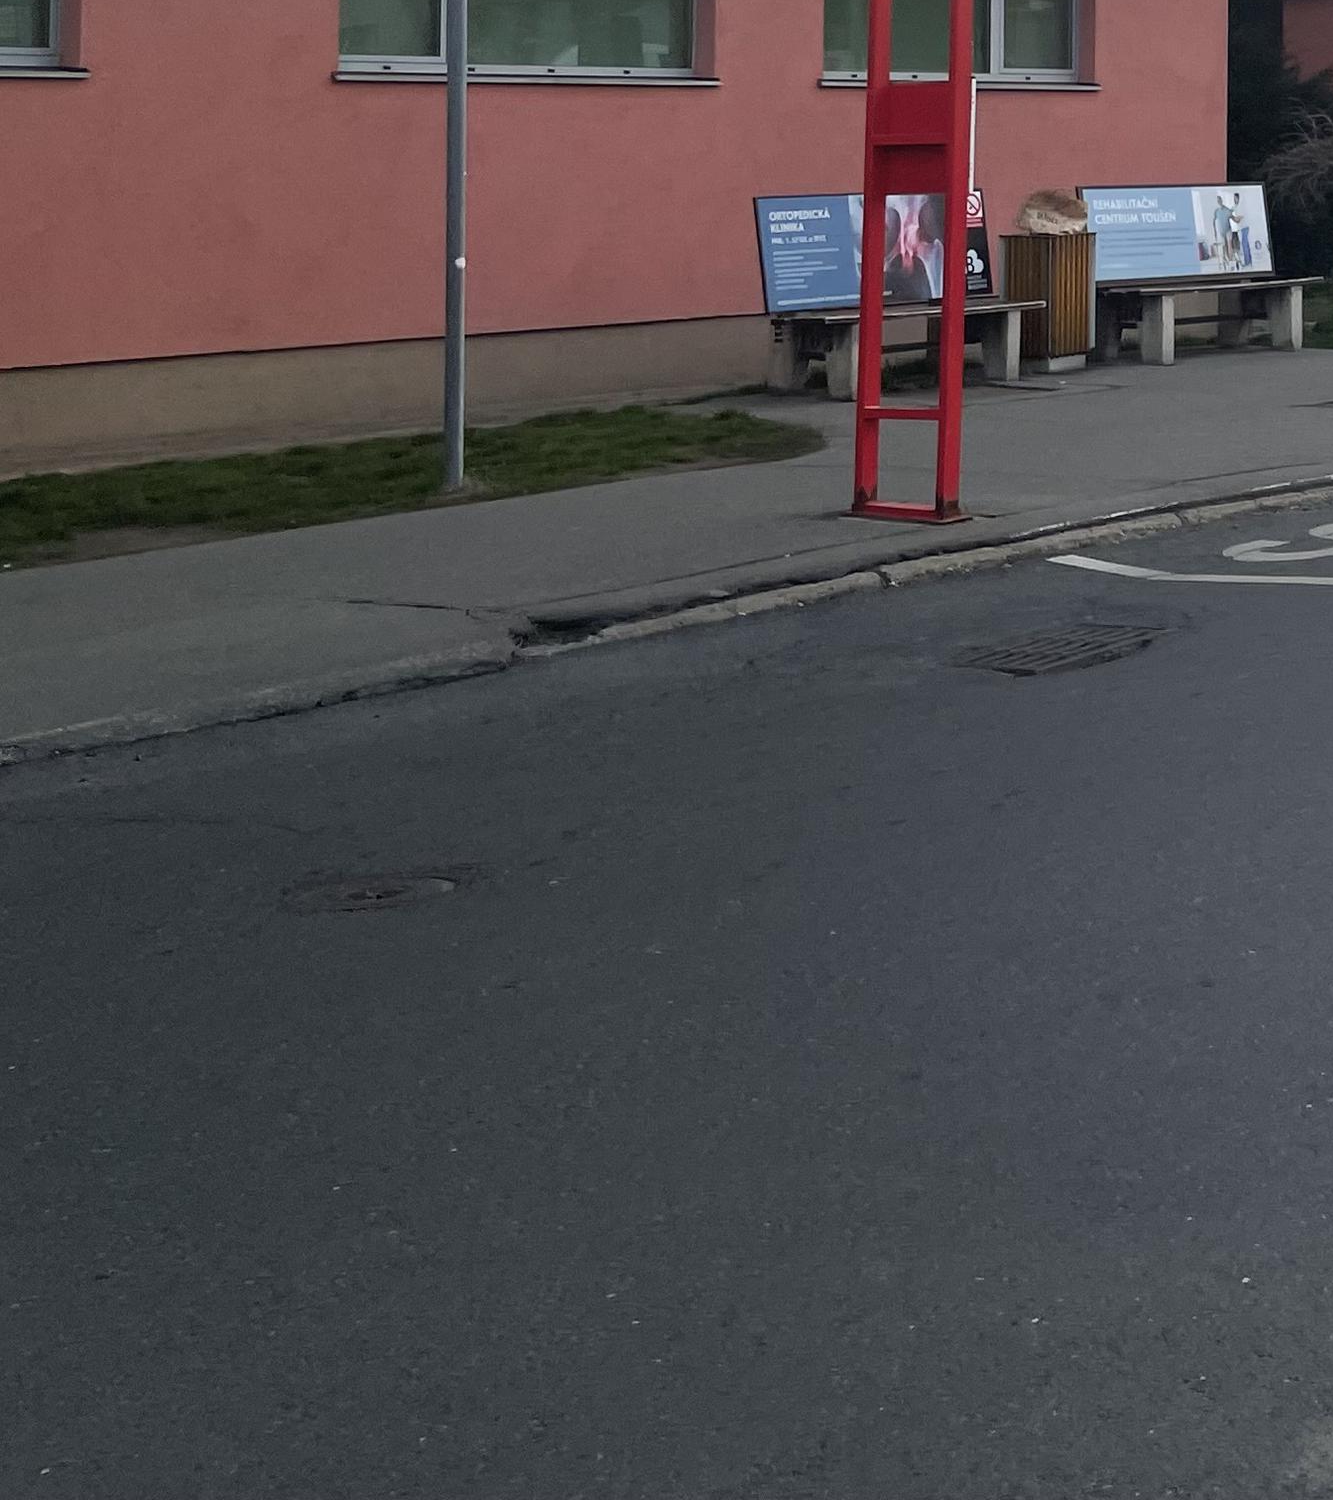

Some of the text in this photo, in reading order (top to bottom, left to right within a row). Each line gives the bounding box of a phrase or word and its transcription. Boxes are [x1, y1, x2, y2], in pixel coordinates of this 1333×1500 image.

[769, 207, 831, 221] ORTOPEDICKÁ
[1095, 213, 1138, 225] CENTRUM
[770, 222, 805, 233] KLINIKA
